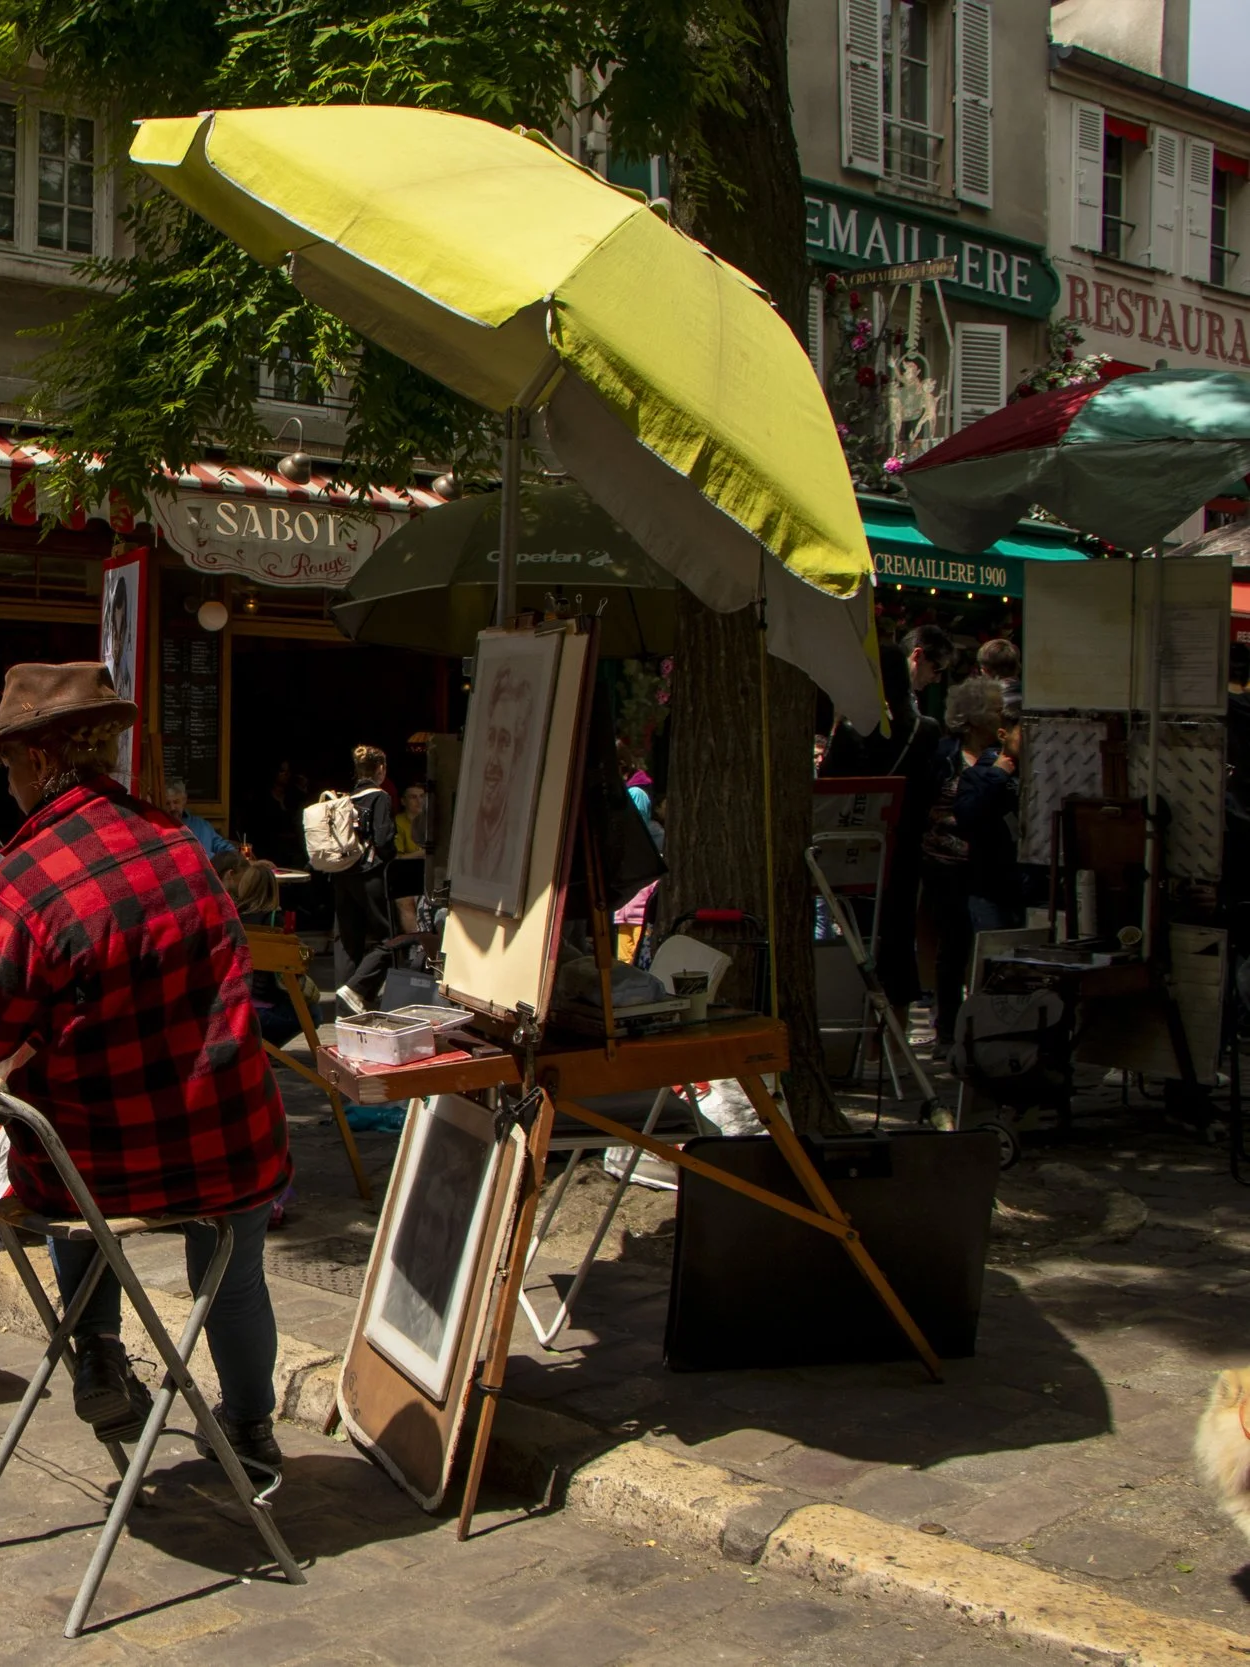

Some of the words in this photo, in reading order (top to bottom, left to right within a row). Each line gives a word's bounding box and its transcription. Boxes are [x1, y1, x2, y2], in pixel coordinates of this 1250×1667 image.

[1066, 273, 1250, 368] RESTAURA
[216, 502, 344, 546] SABOT
[280, 552, 351, 579] Rouge
[486, 549, 582, 565] Cperlan
[874, 552, 976, 584] CREMAILLERE
[979, 565, 1007, 587] 1900
